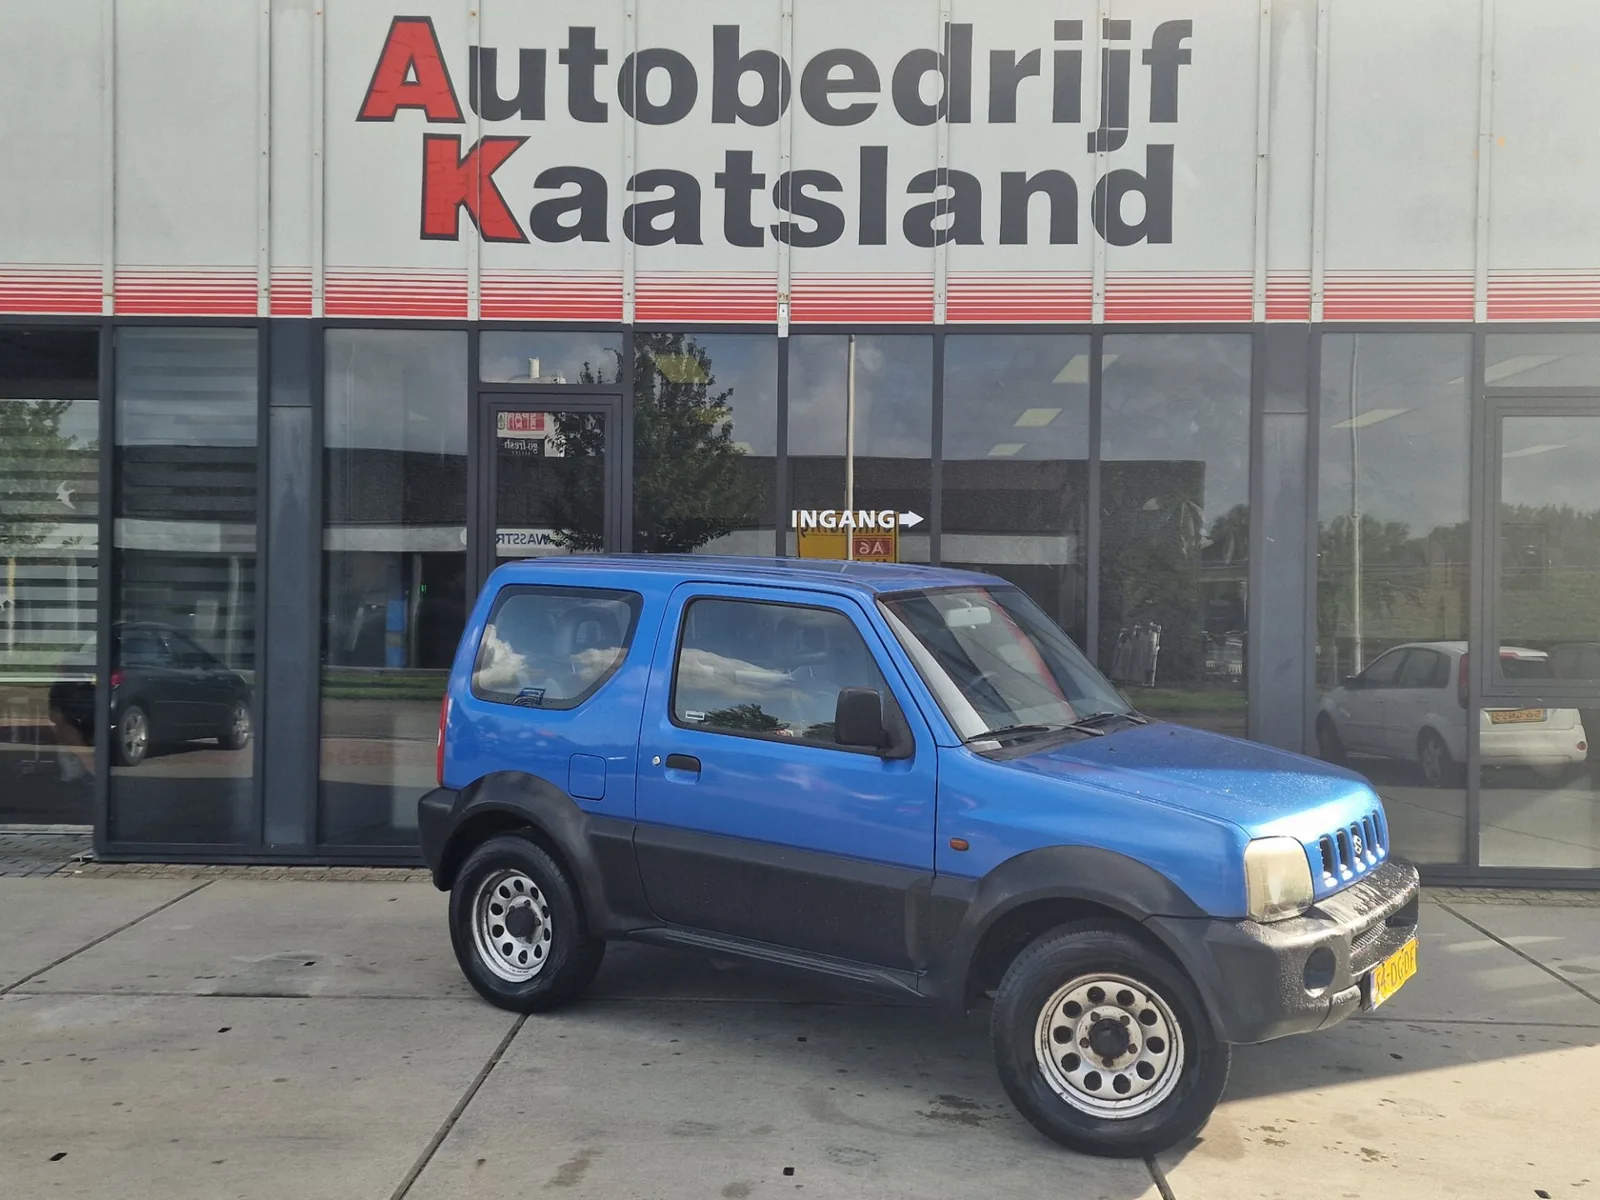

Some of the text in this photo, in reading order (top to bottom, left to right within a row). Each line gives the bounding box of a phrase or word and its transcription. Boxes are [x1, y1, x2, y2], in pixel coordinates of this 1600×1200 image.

[356, 15, 1193, 153] Autobedrijf
[420, 133, 1175, 248] Kaatsland
[791, 509, 896, 529] INGANG
